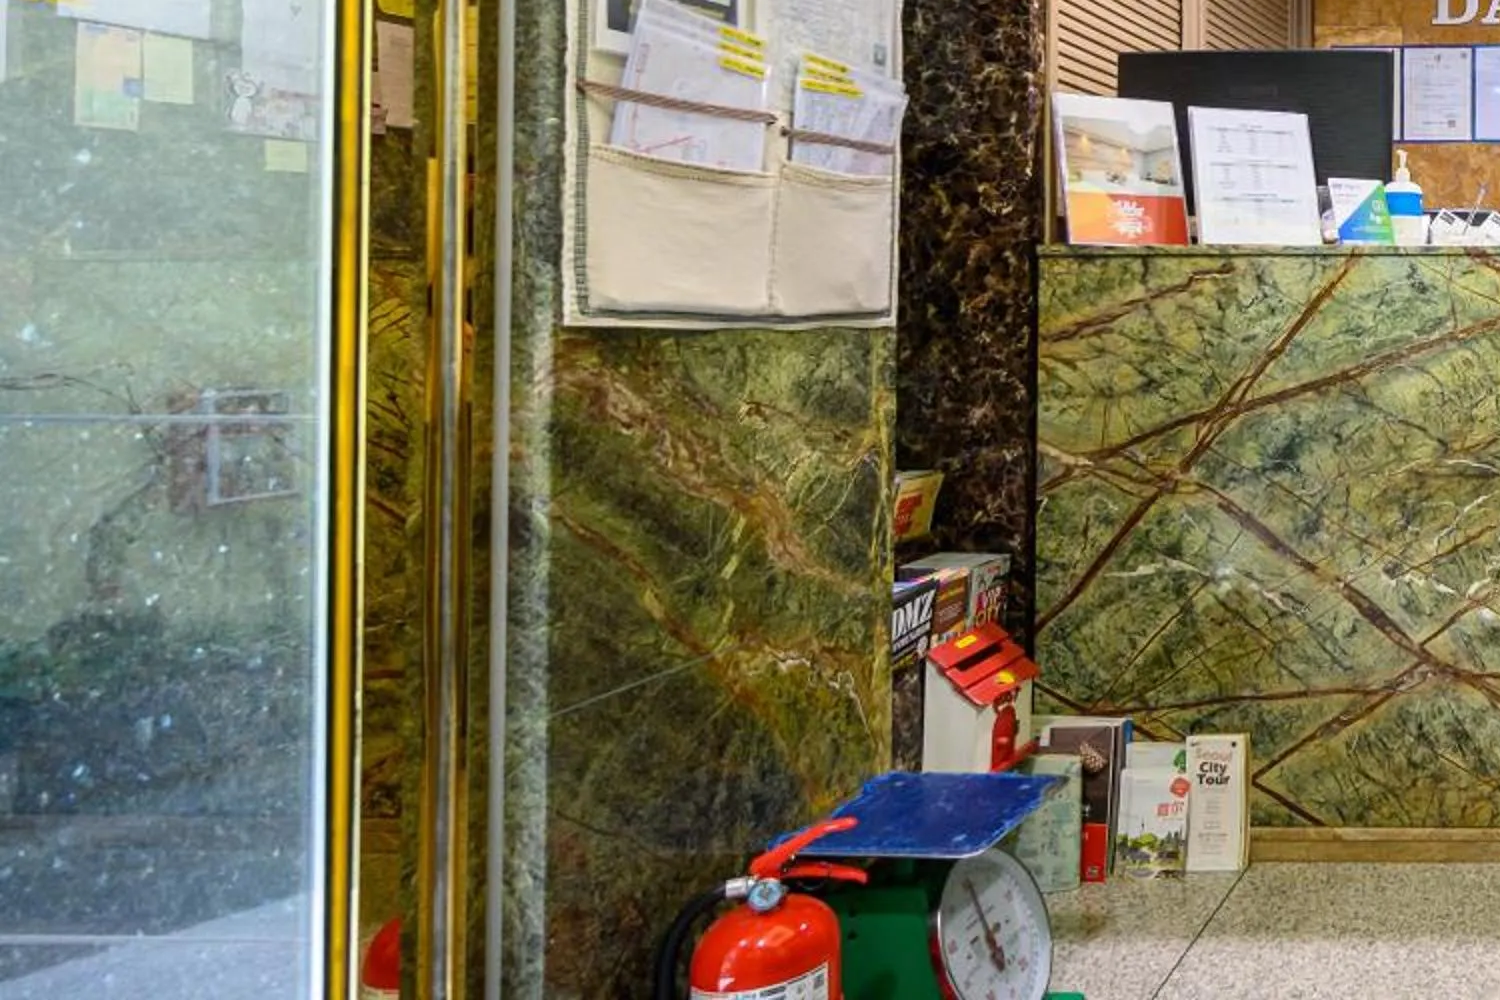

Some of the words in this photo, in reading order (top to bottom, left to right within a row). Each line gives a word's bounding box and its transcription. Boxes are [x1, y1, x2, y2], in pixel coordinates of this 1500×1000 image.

[892, 589, 937, 640] DMZ
[1199, 761, 1228, 774] City
[1196, 773, 1231, 785] Tour
